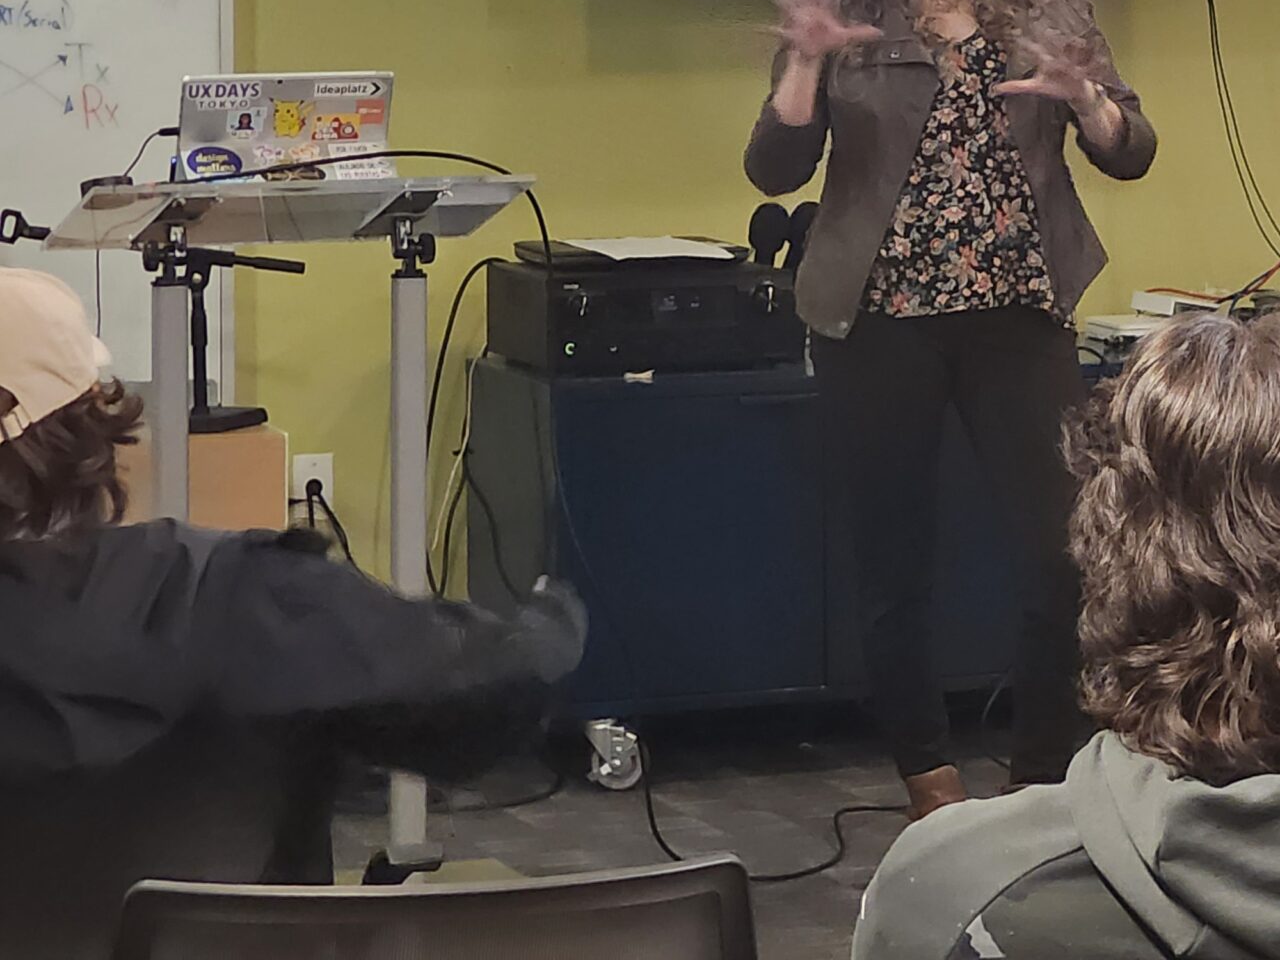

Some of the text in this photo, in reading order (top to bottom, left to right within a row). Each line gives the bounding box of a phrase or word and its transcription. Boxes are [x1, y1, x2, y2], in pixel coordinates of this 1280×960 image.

[188, 83, 260, 98] UX DAYS
[316, 84, 368, 95] Ideaplatz
[199, 100, 248, 109] TOKYO
